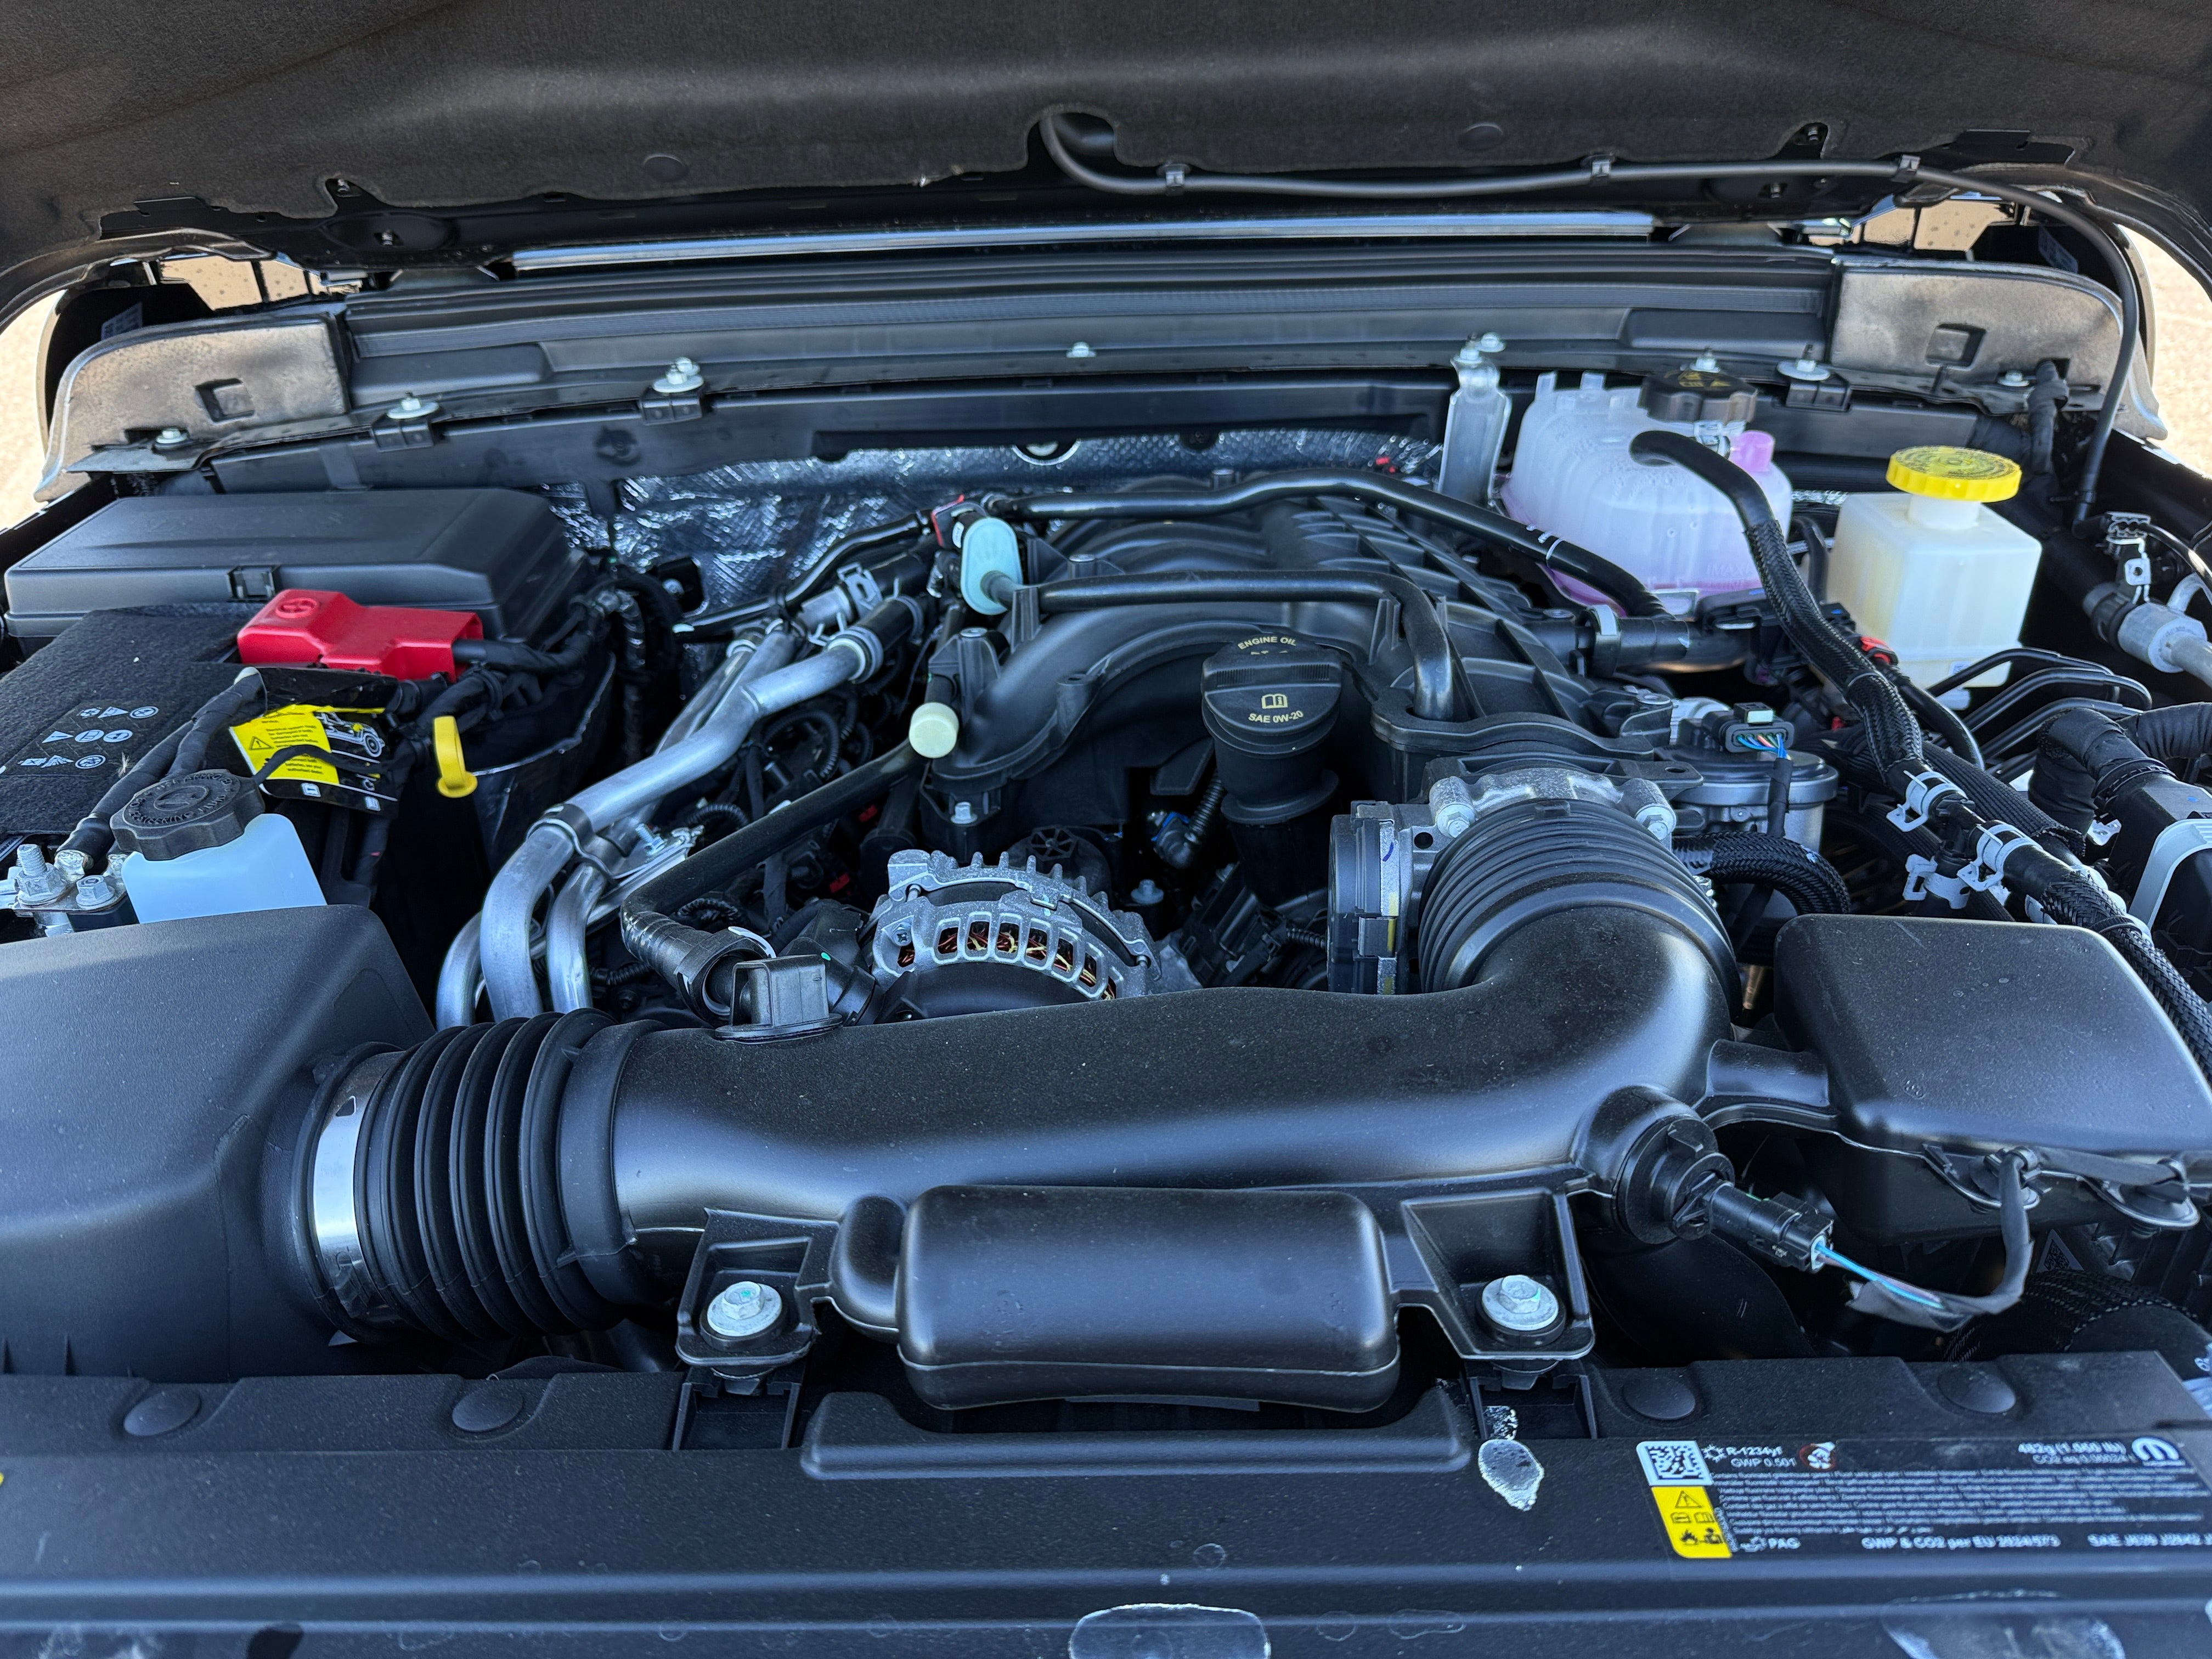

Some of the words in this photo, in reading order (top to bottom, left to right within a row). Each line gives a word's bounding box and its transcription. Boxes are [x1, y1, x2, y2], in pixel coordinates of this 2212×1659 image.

[1237, 636, 1277, 650] ENGINE
[1280, 636, 1297, 646] OIL
[1248, 713, 1271, 723] SAE
[1273, 710, 1304, 723] 0W-20
[1726, 1446, 1782, 1457] R-1234yf
[1731, 1457, 1762, 1468] GWP
[1764, 1457, 1797, 1468] 0.501
[1768, 1537, 1801, 1549] PAG
[1861, 1537, 1897, 1549] GWP
[1914, 1536, 1946, 1548] CO2
[2087, 1533, 2123, 1547] SAE
